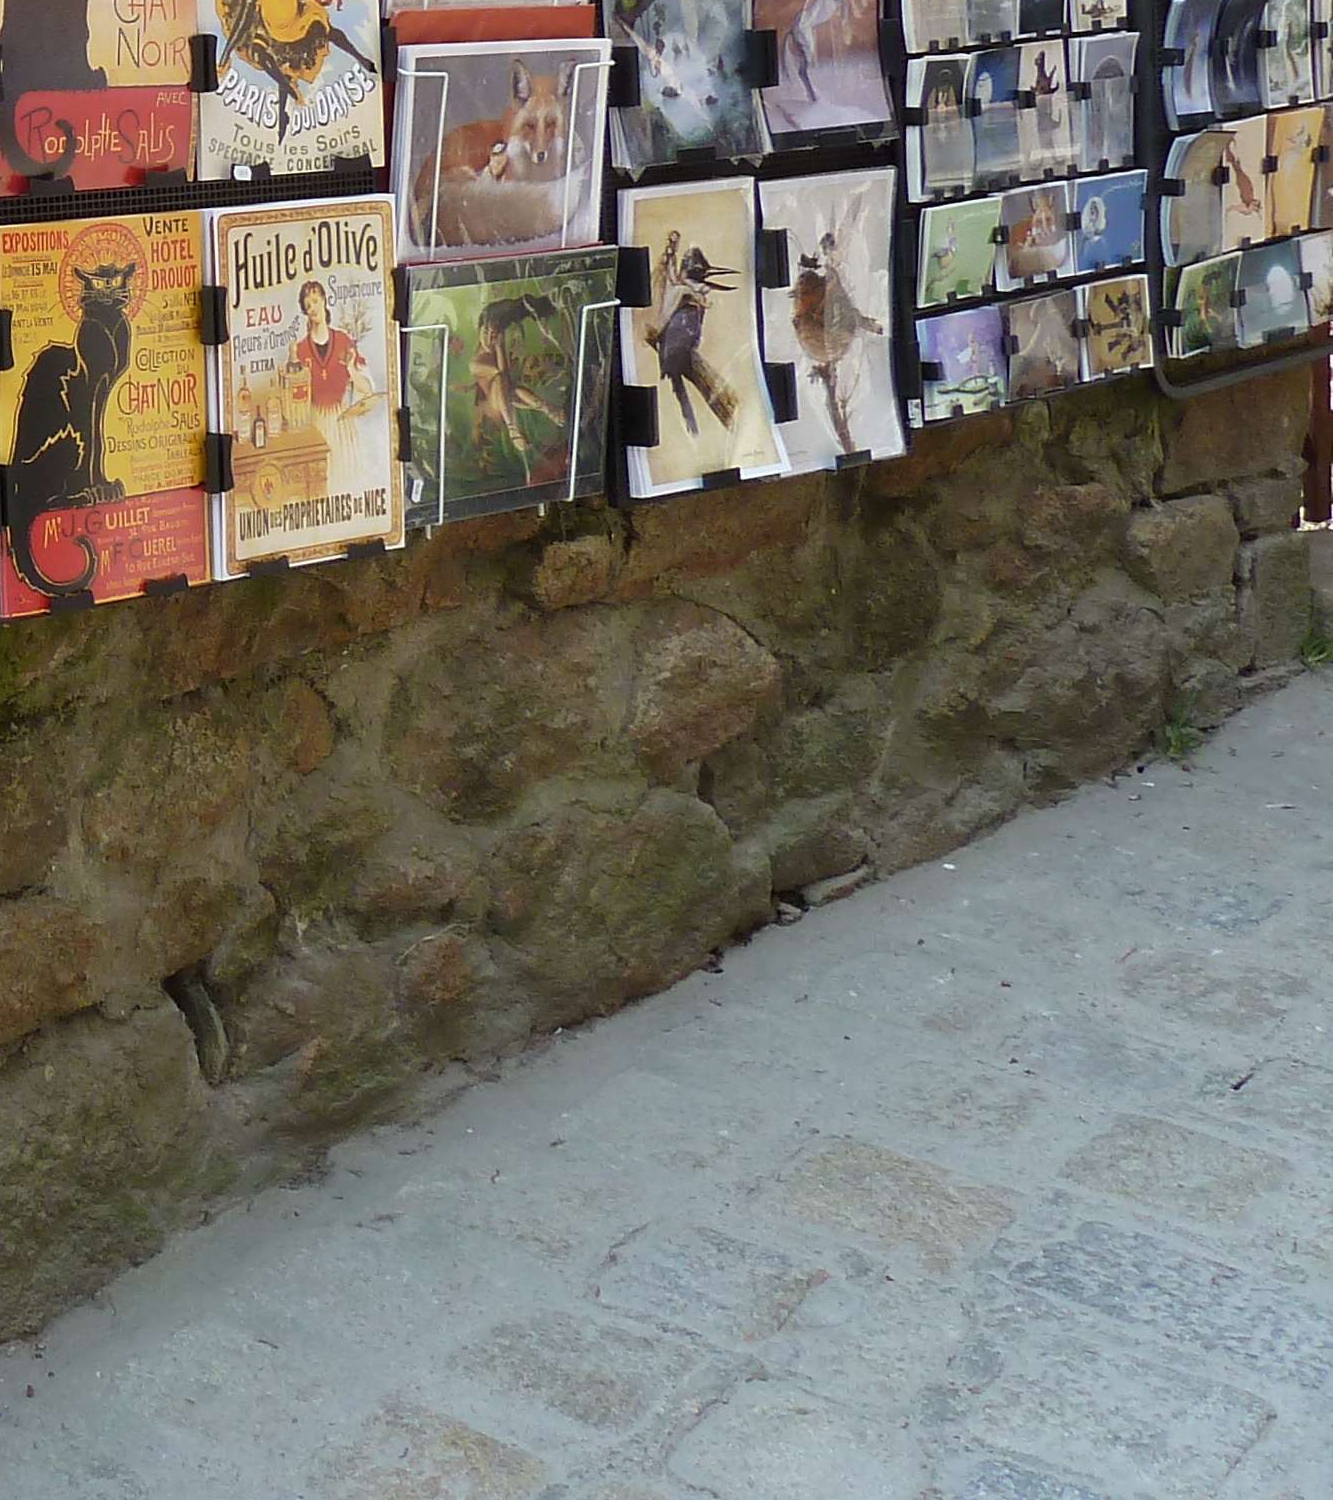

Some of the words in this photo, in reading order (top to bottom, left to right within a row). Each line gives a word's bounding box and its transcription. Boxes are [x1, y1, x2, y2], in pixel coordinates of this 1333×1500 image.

[117, 26, 190, 77] NOIR
[155, 91, 188, 107] AVEC
[217, 68, 279, 129] PARIS
[315, 62, 378, 126] DANSE
[232, 123, 276, 155] Tous
[282, 143, 310, 157] les
[315, 125, 362, 153] Soirs
[142, 216, 189, 237] VENTE
[1, 229, 70, 255] EXPOSITIONS
[150, 235, 195, 264] HÔTEL
[151, 264, 198, 292] DROUOT
[232, 230, 298, 309] Huile
[302, 219, 379, 274] d'Olive
[244, 304, 284, 329] EAU
[249, 357, 276, 374] EXTRA
[238, 507, 270, 542] UNION
[364, 487, 387, 520] NICE
